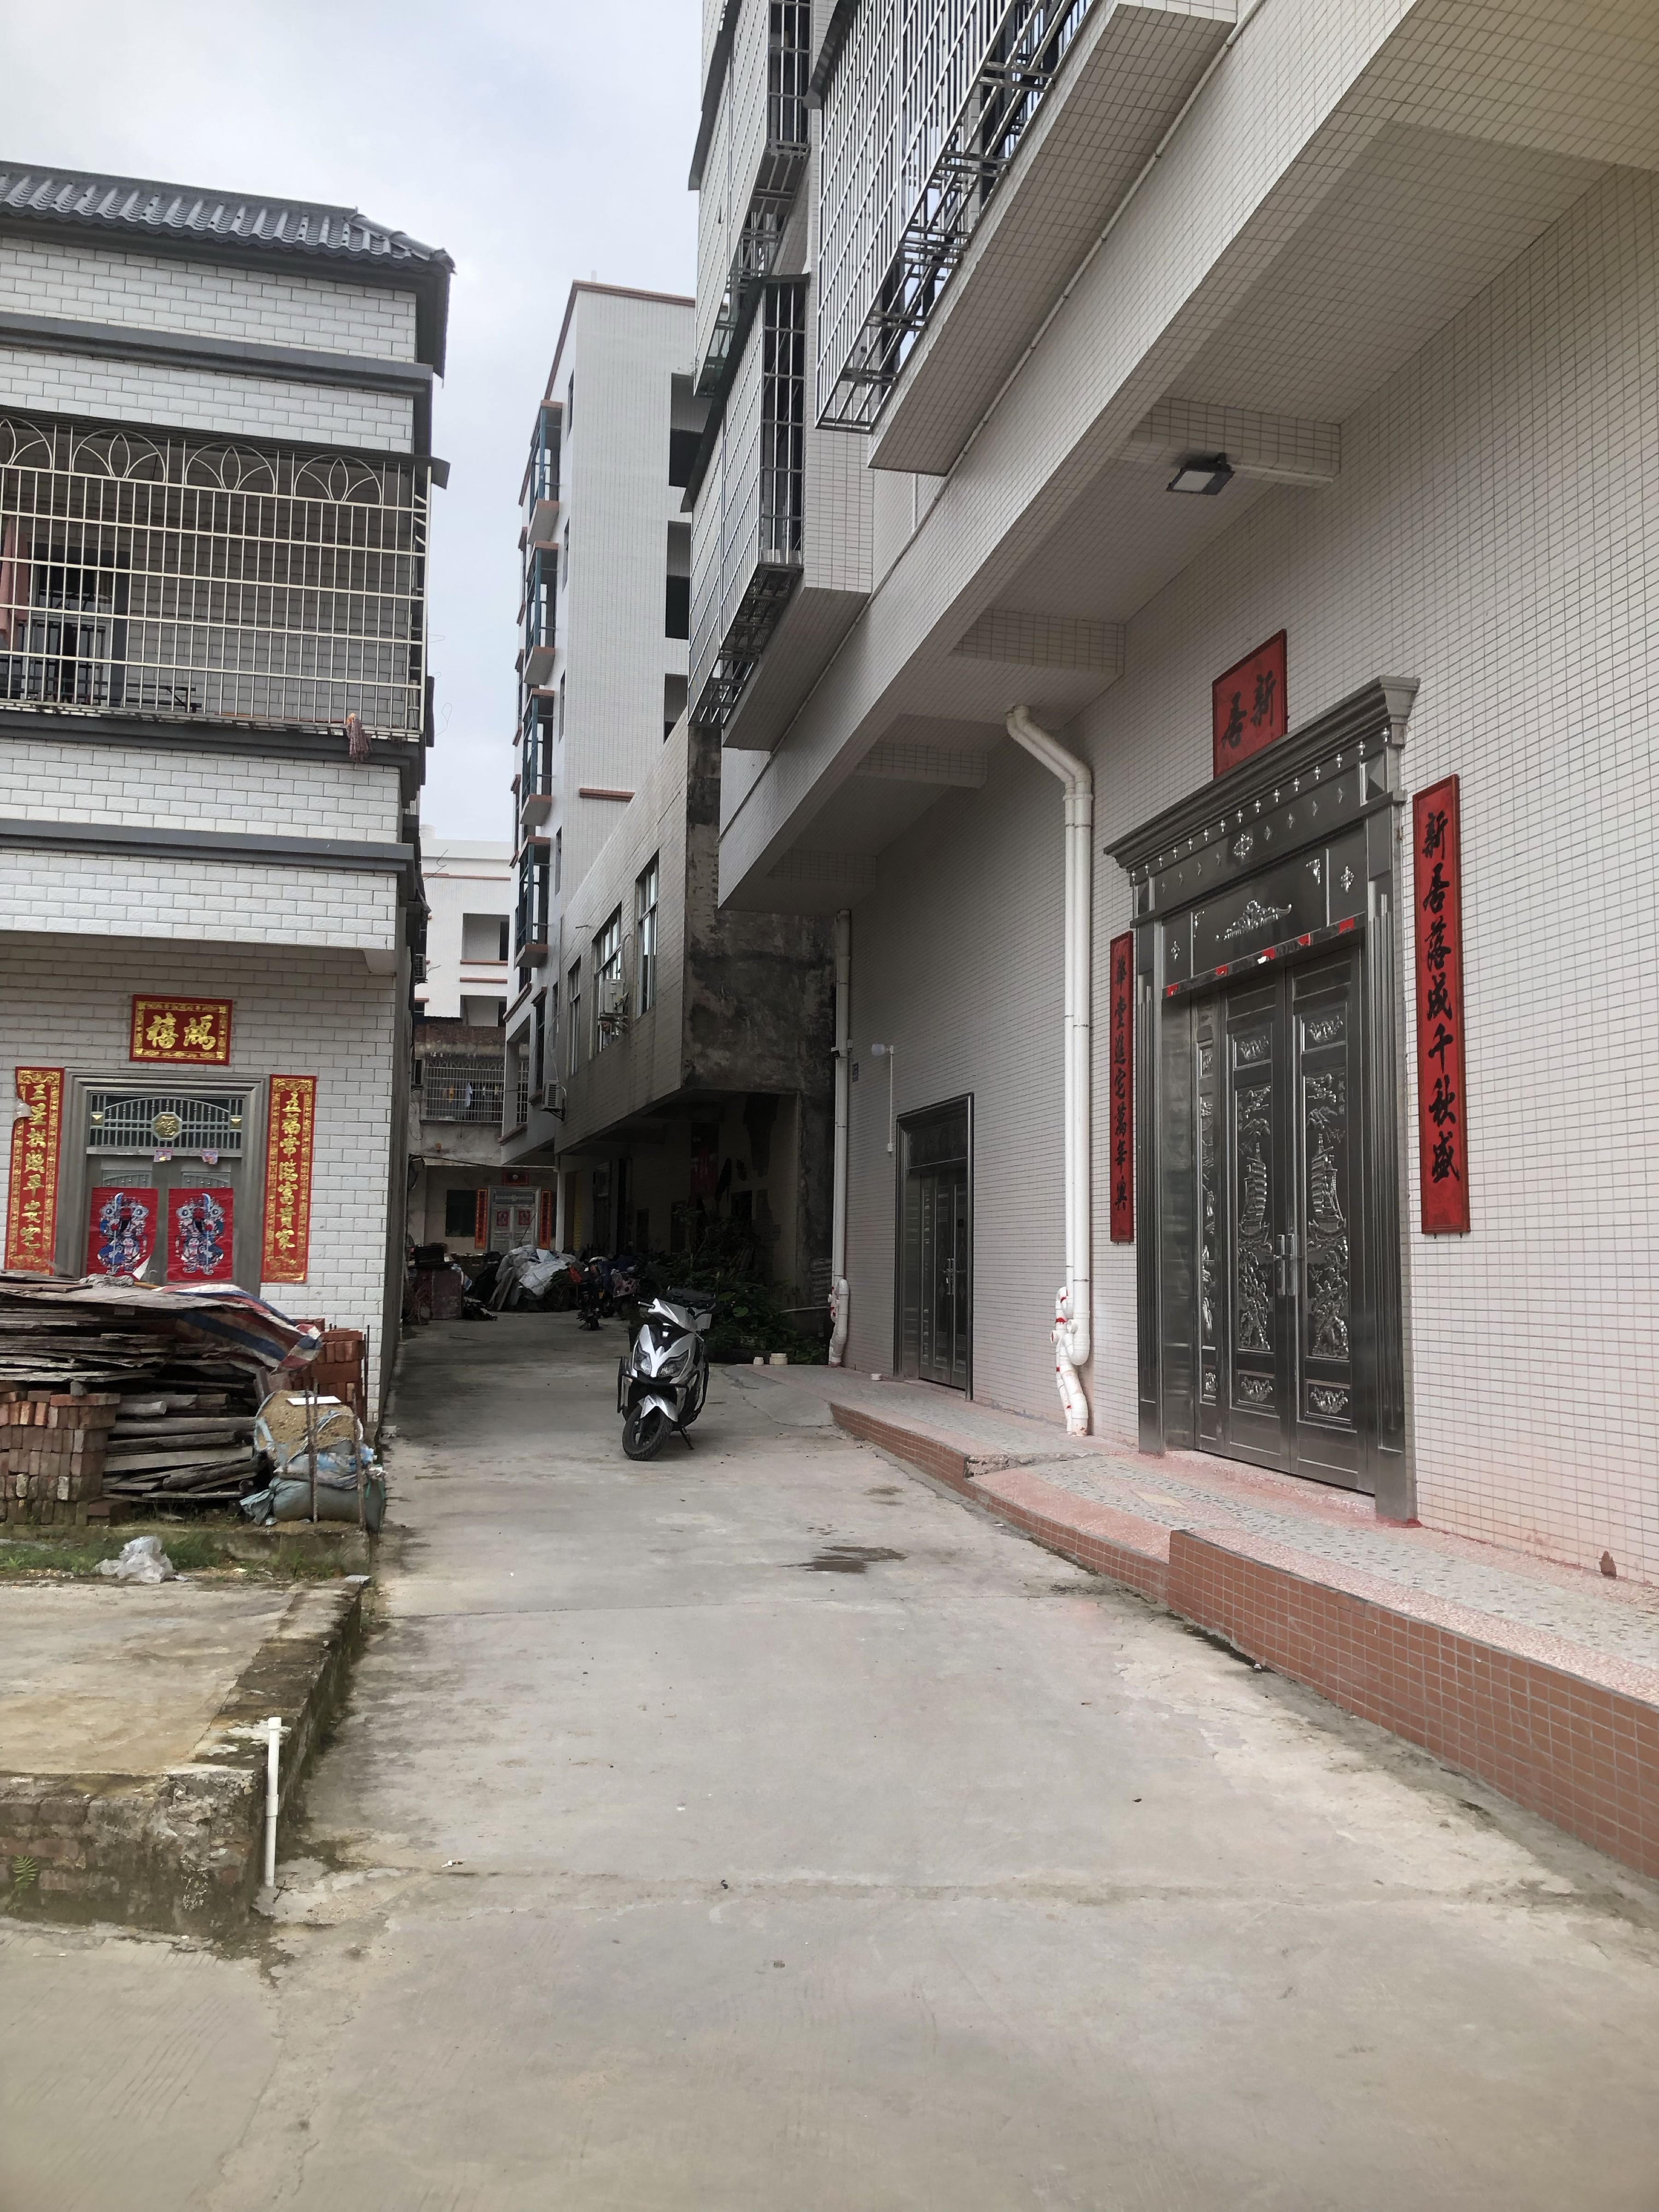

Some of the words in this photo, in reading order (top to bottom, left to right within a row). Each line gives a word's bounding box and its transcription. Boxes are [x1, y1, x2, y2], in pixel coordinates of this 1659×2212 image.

[1221, 670, 1277, 749] 新居
[1423, 809, 1460, 1183] 新居落成千秋盛
